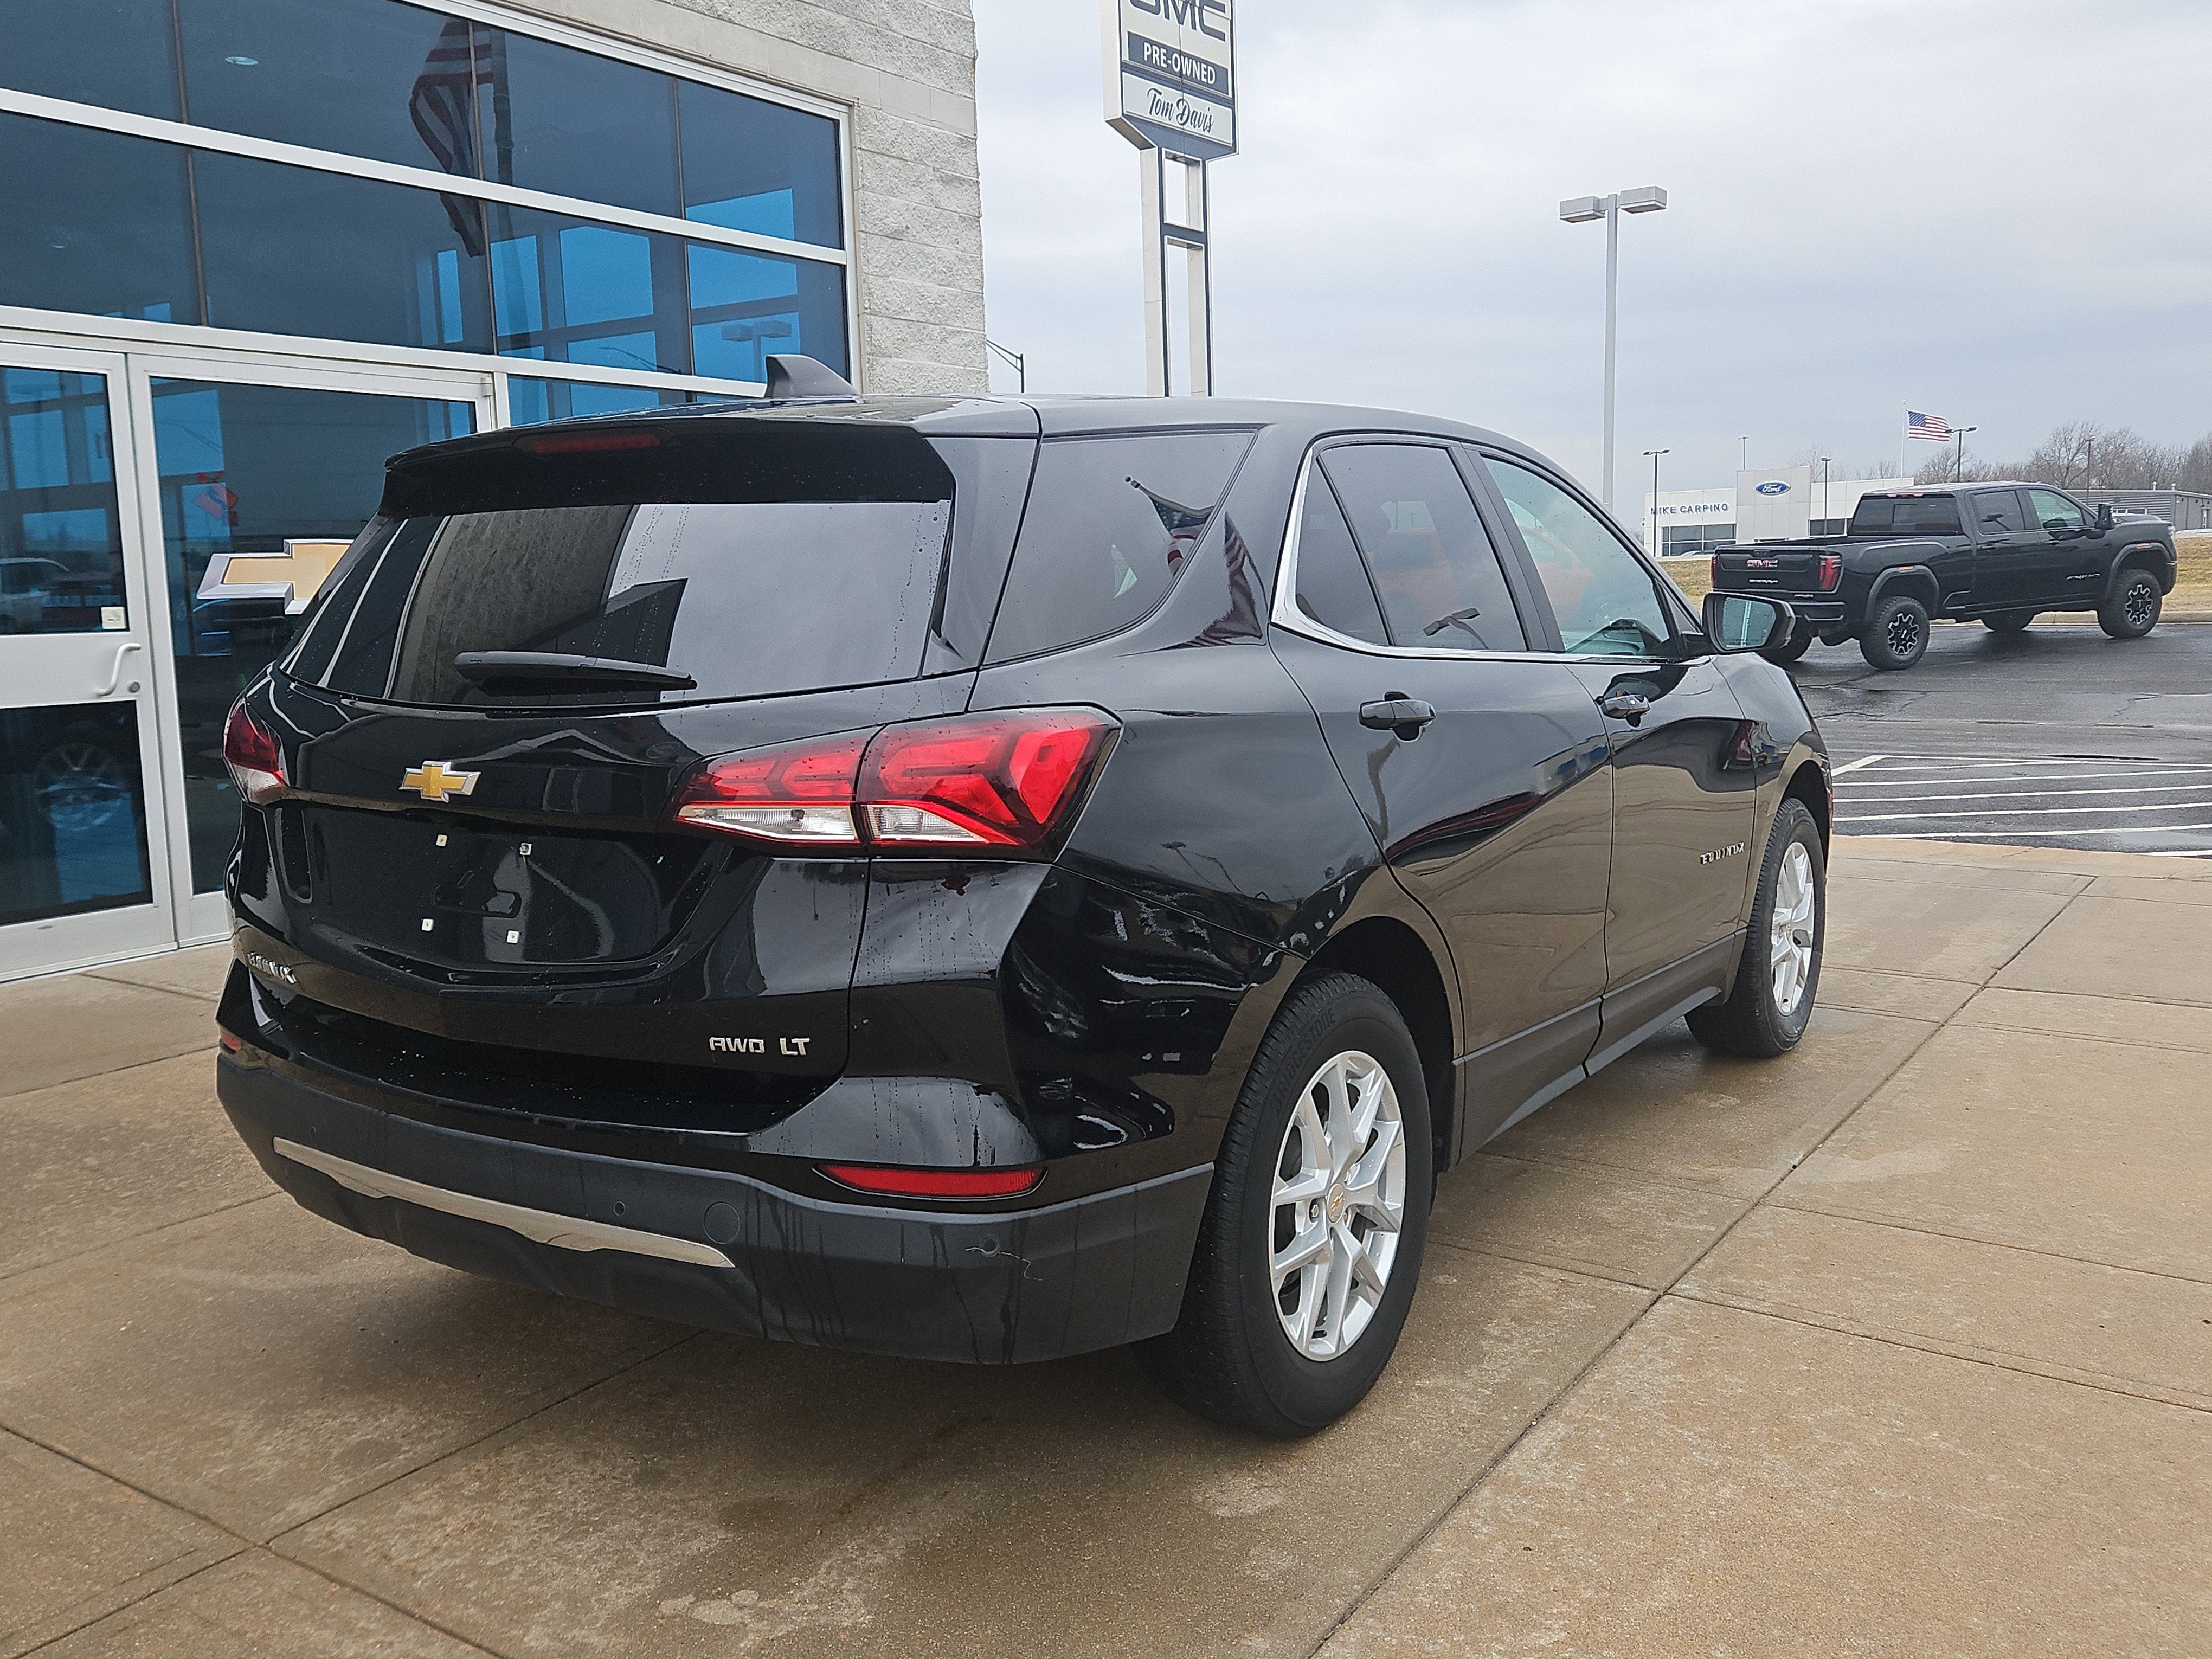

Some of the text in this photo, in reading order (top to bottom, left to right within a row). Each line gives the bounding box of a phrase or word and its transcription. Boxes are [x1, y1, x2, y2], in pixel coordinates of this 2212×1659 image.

[1130, 0, 1226, 42] MC
[1143, 42, 1216, 85] PRE-OWNED
[1147, 87, 1214, 133] Tom Davis
[1762, 484, 1783, 493] Ford
[1680, 503, 1729, 513] CARPINO
[1746, 559, 1778, 568] GMC
[1700, 842, 1745, 865] EQUINOX
[709, 1037, 811, 1056] AWD LT
[1271, 1006, 1336, 1116] BRIDGESTONE
